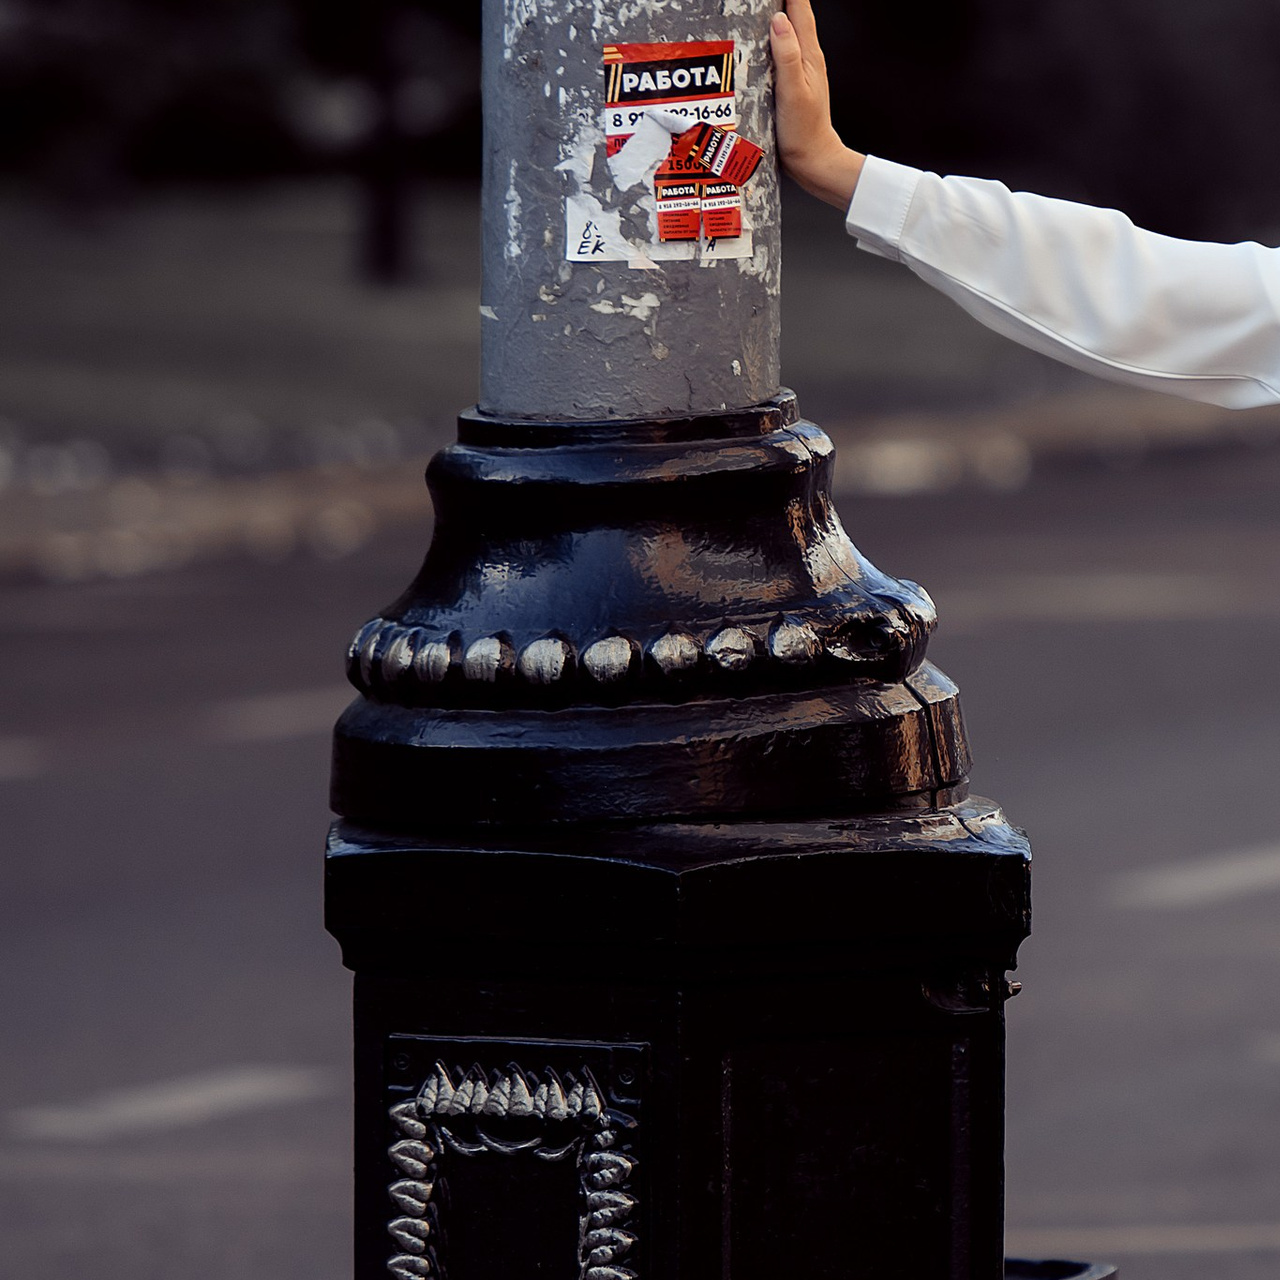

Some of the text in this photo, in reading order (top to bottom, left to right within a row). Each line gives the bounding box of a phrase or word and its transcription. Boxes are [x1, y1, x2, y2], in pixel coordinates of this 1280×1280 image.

[622, 66, 721, 93] РАБОТА
[612, 113, 623, 128] 8
[703, 131, 722, 163] РАБОТА
[662, 186, 695, 197] РАБОТА
[706, 184, 737, 195] РАБОТА
